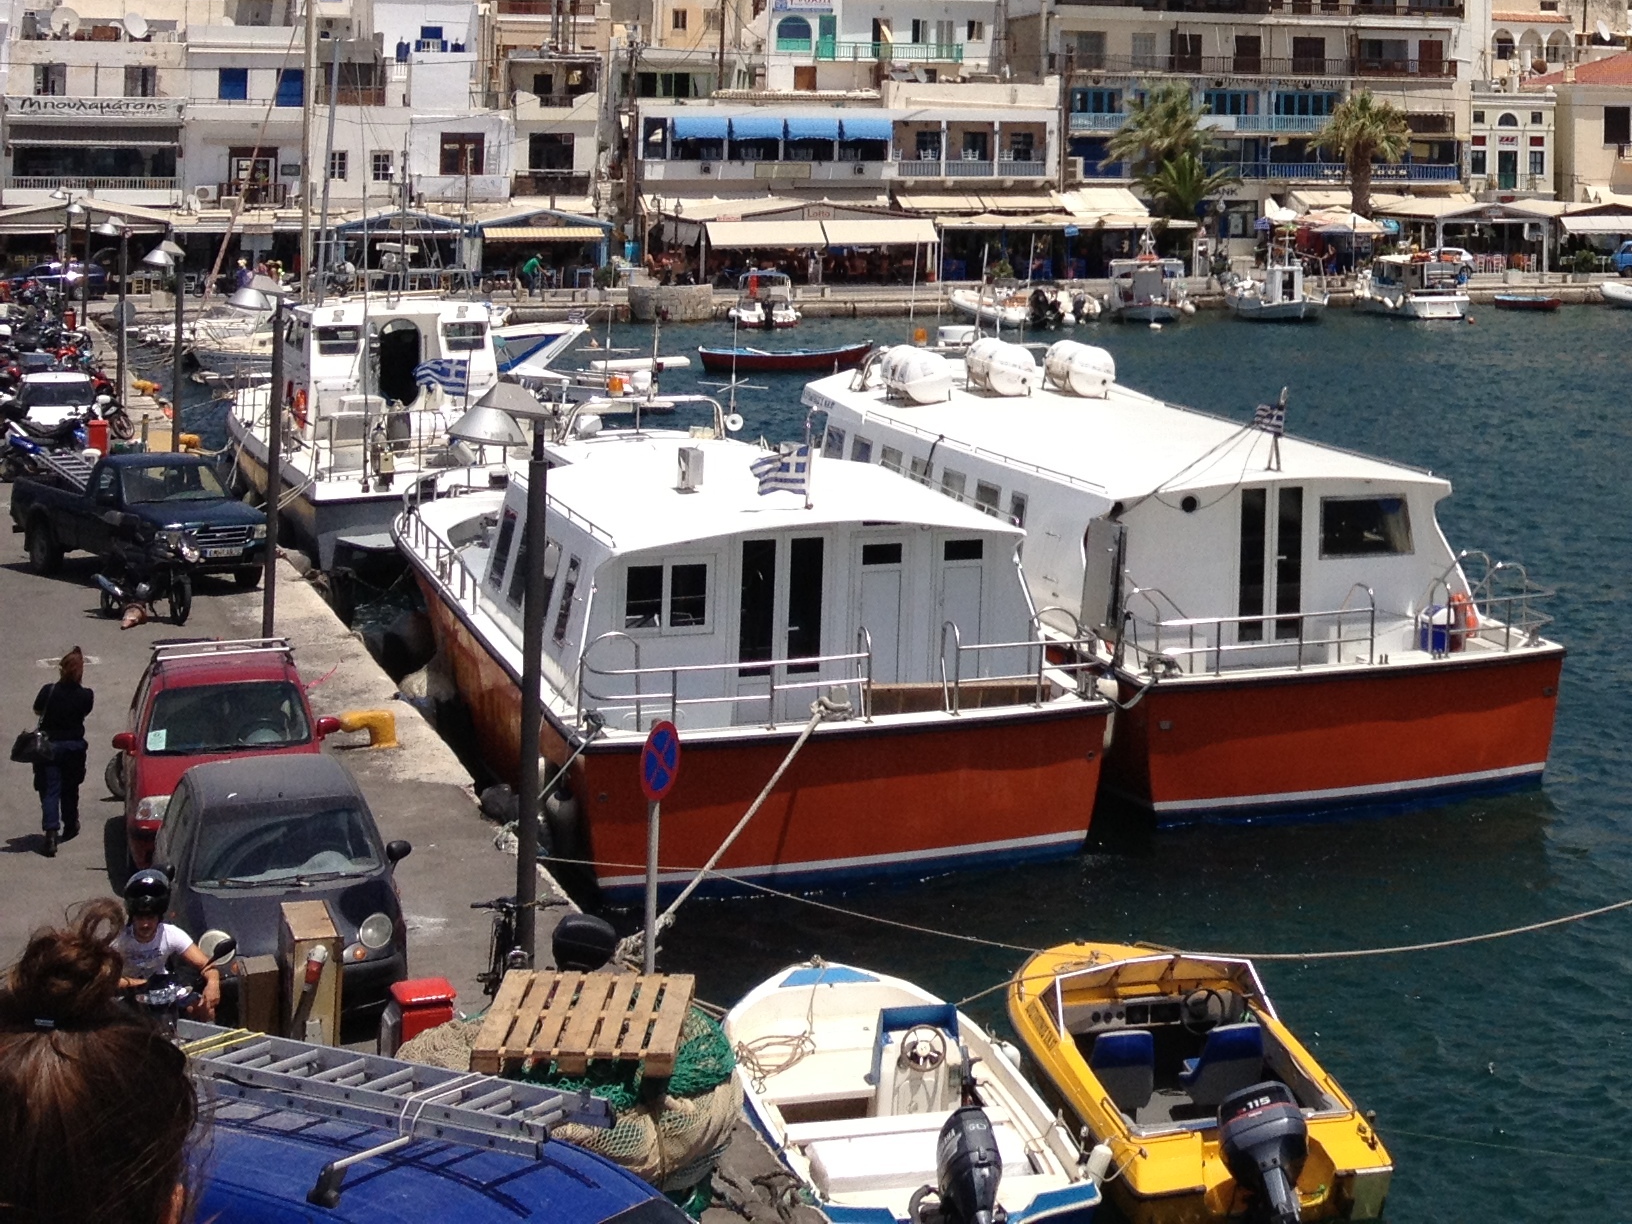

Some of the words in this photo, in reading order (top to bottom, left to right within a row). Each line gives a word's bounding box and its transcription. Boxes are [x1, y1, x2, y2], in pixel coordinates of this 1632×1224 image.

[1211, 187, 1239, 197] ANK
[807, 207, 831, 218] Lotto
[1246, 1095, 1271, 1109] 115
